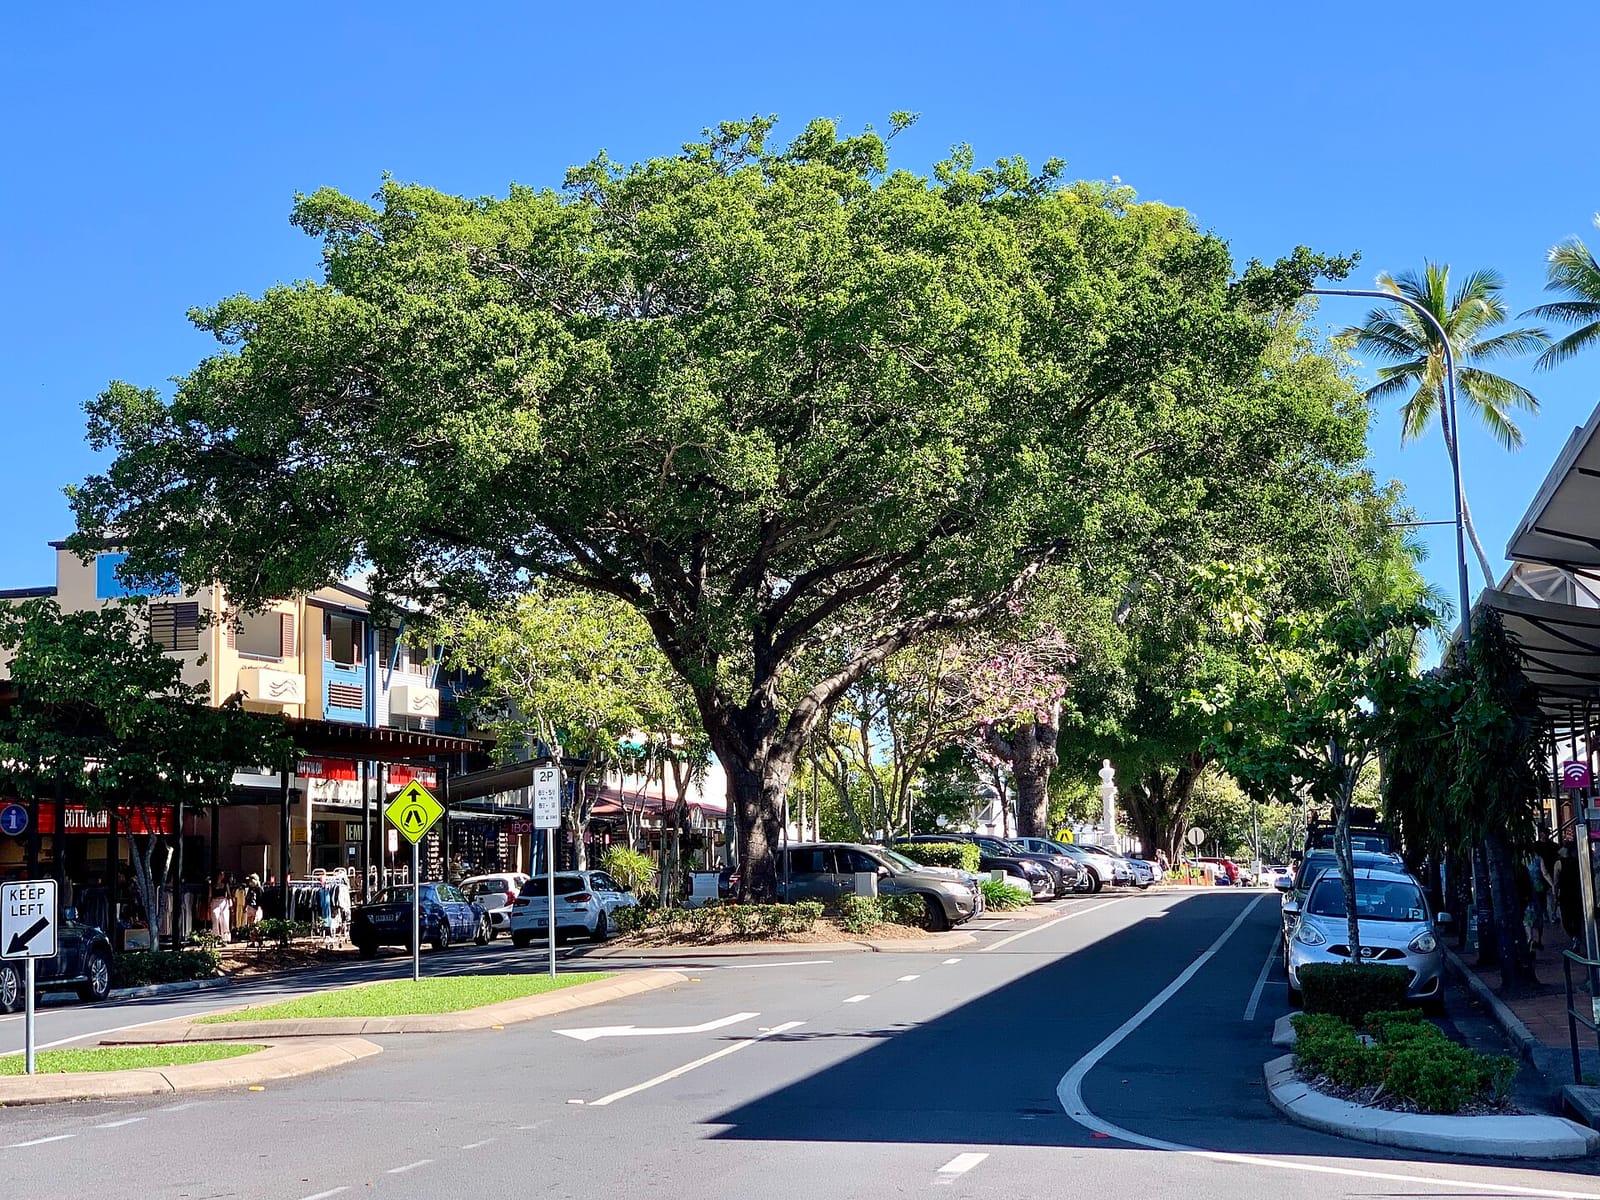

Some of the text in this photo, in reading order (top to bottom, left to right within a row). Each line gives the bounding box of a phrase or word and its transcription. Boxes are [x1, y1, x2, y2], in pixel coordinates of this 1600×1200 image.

[540, 771, 554, 782] 2P
[9, 809, 17, 829] i
[10, 888, 46, 901] KEEP
[11, 903, 44, 917] LEFT
[1412, 909, 1420, 919] P
